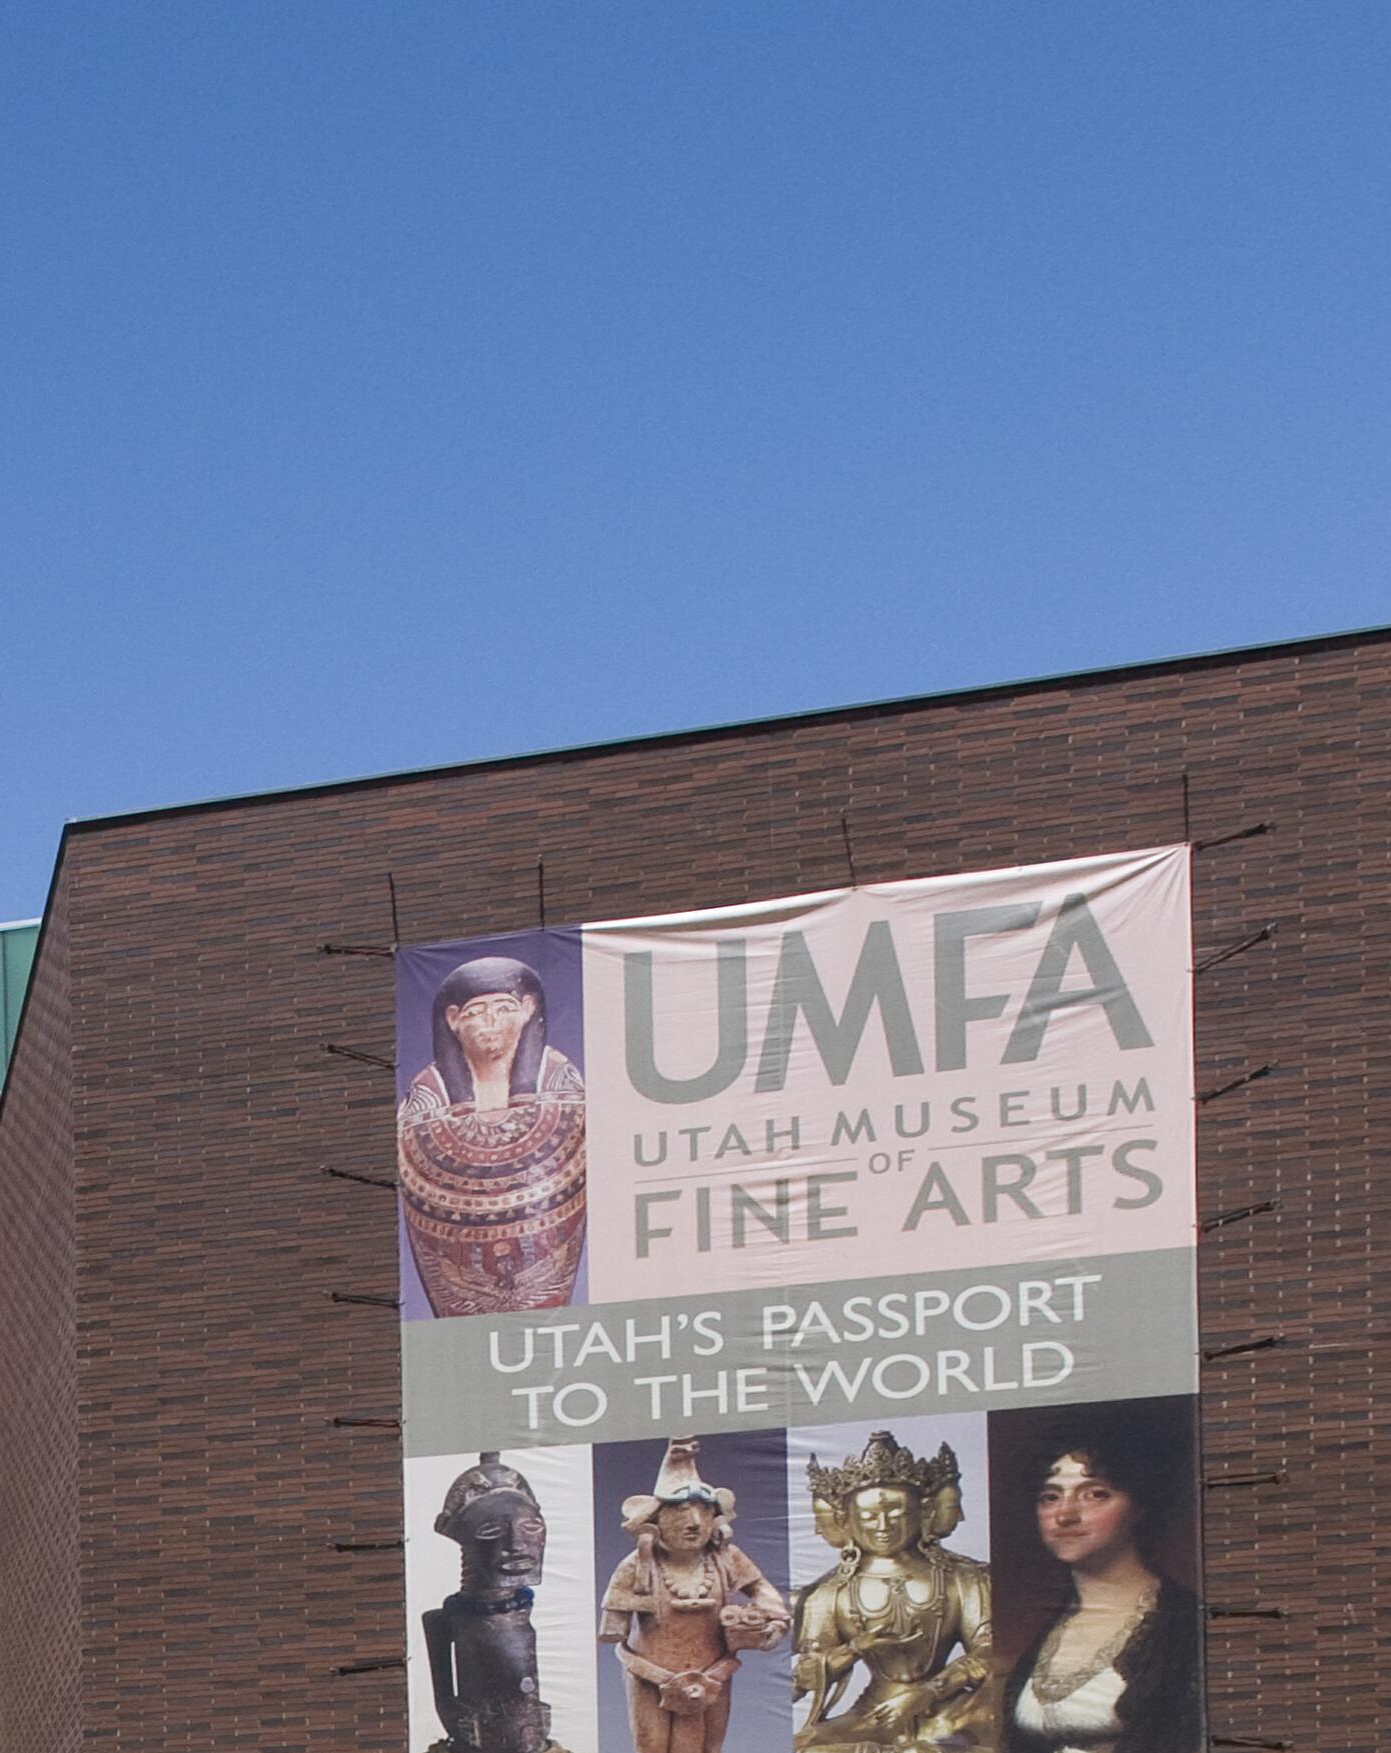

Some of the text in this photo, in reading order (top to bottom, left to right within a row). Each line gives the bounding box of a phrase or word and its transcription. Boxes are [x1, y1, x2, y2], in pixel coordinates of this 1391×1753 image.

[625, 893, 1153, 1105] UMFA
[635, 1077, 1155, 1167] UTAH MUSEUM
[868, 1150, 915, 1174] OF
[635, 1139, 1163, 1260] FINE ARTS
[763, 1274, 1102, 1351] PASSPORT
[512, 1342, 1074, 1430] TO THE WORLD
